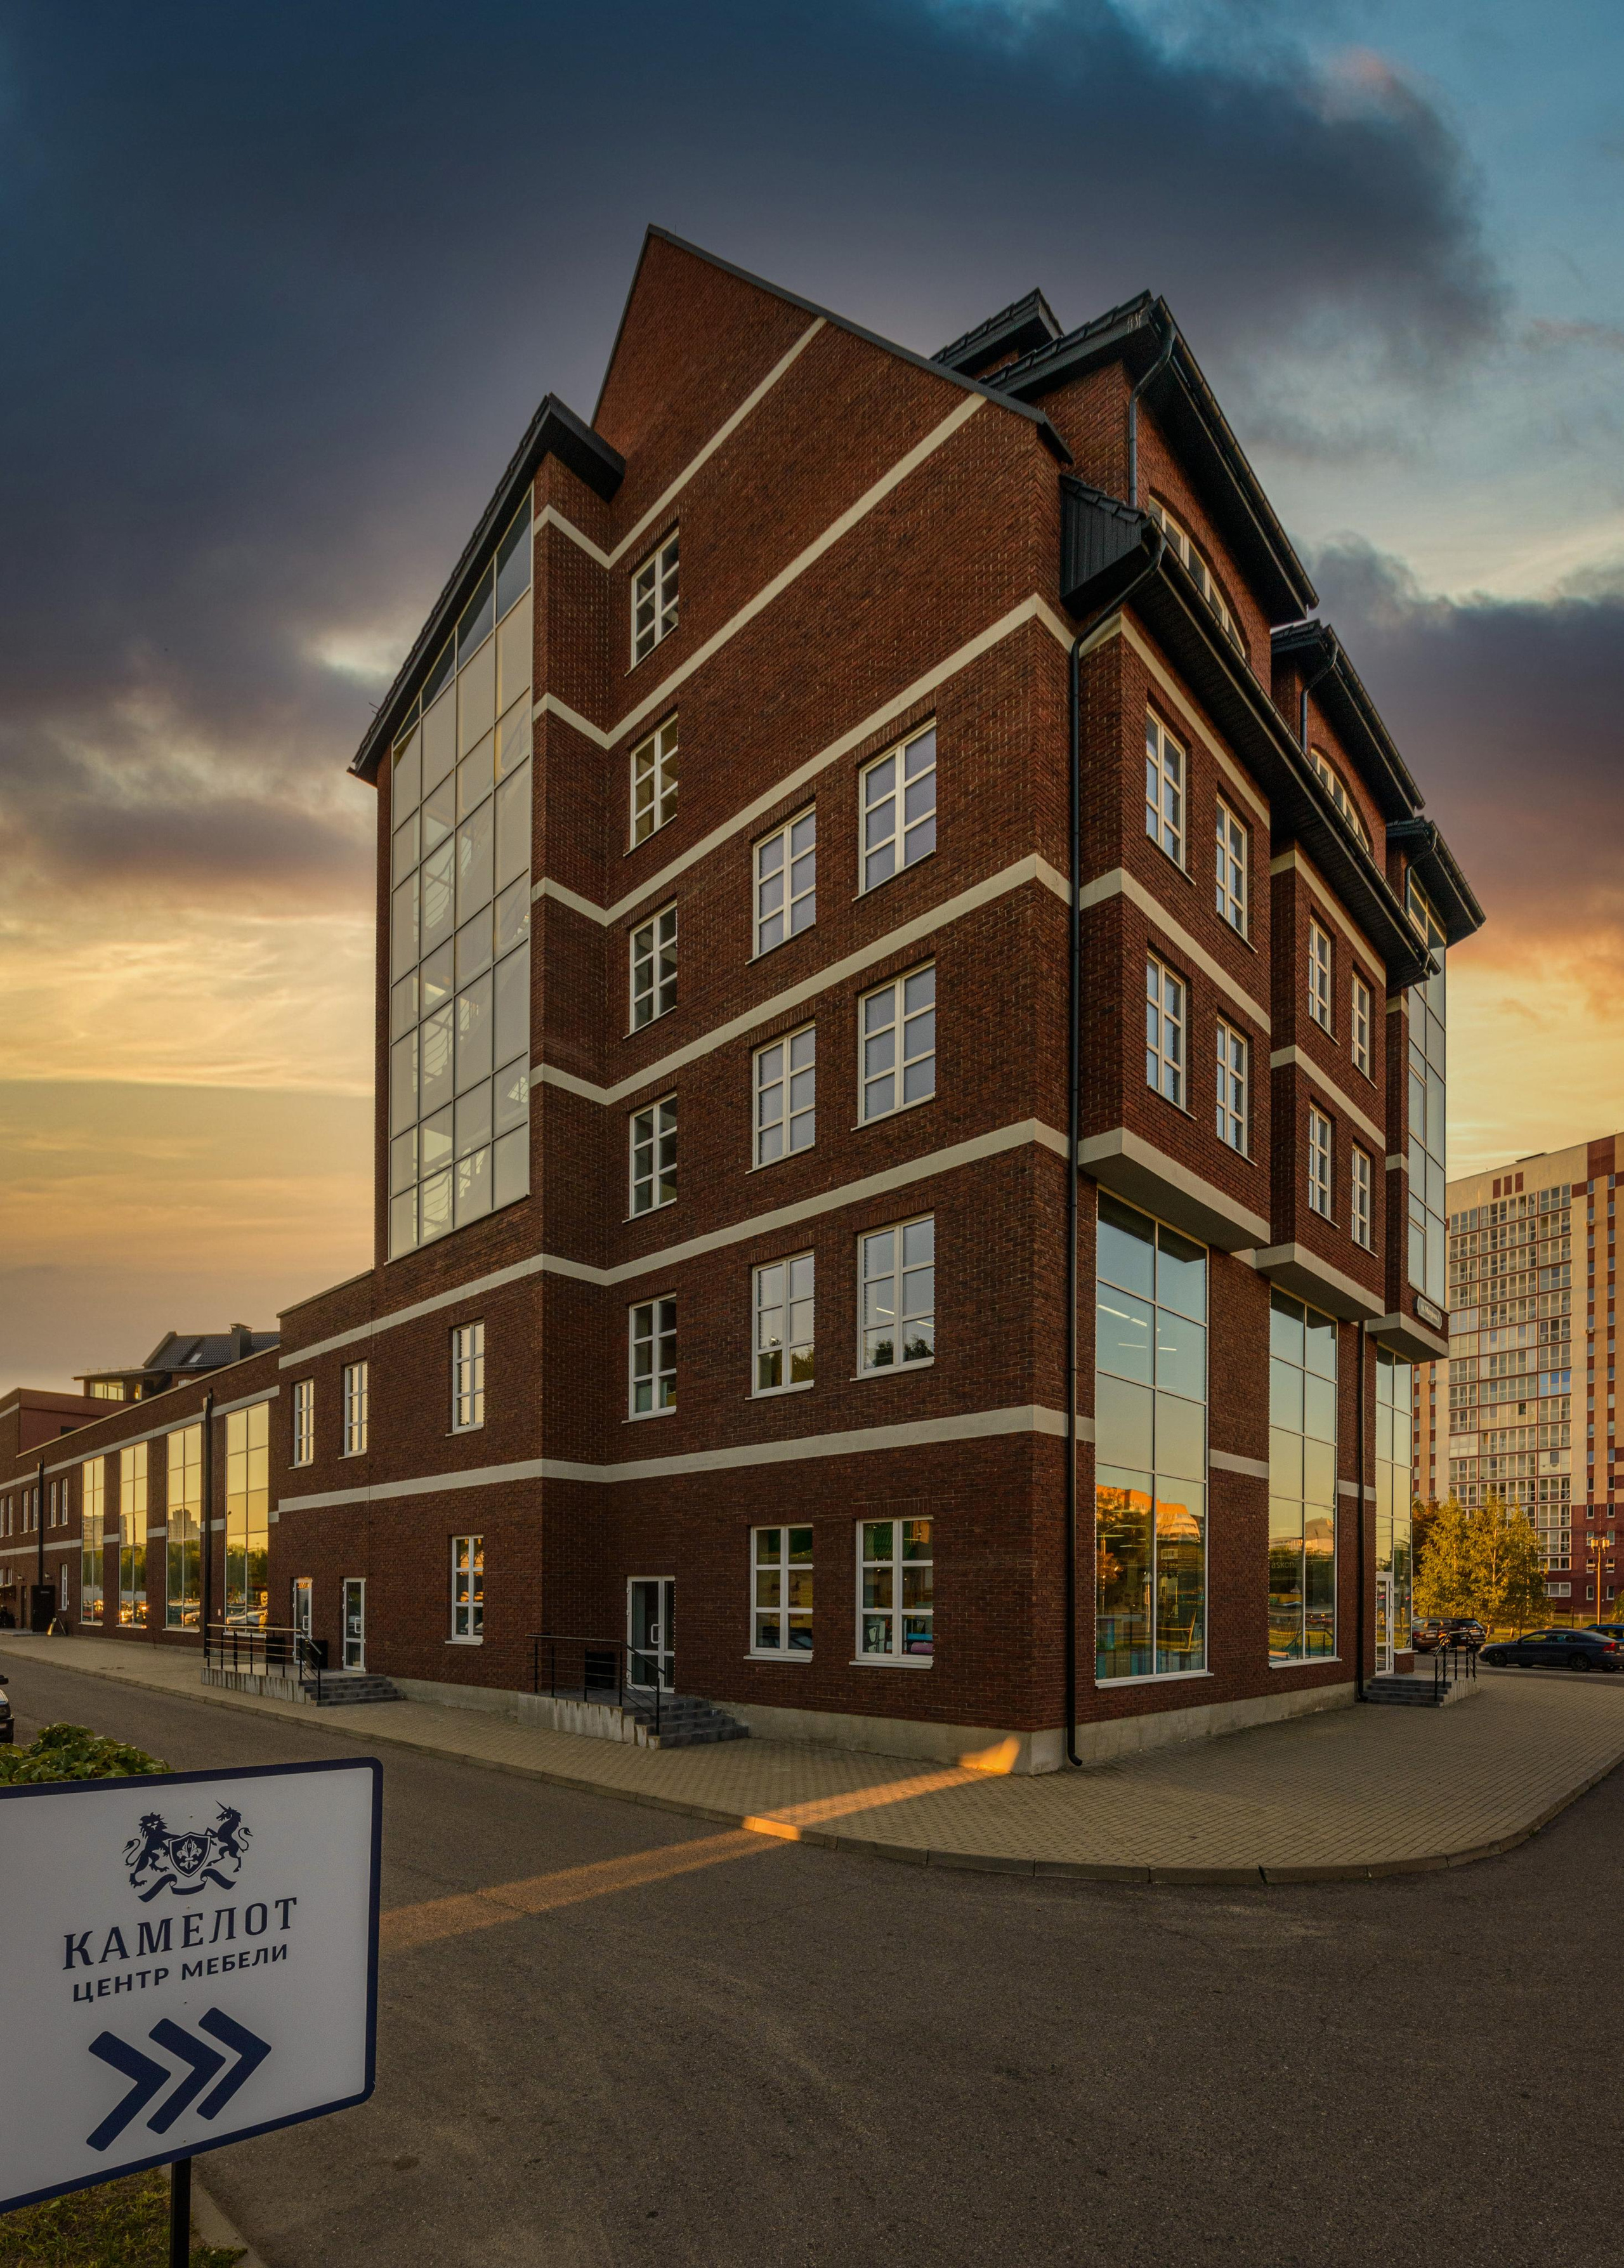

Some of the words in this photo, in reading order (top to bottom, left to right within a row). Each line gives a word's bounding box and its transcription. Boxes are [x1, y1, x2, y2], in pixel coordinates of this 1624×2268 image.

[63, 1897, 298, 1970] КАМЕЛОТ
[73, 1968, 169, 2003] ЦЕНТР
[181, 1943, 288, 1981] МЕБЕЛИ
